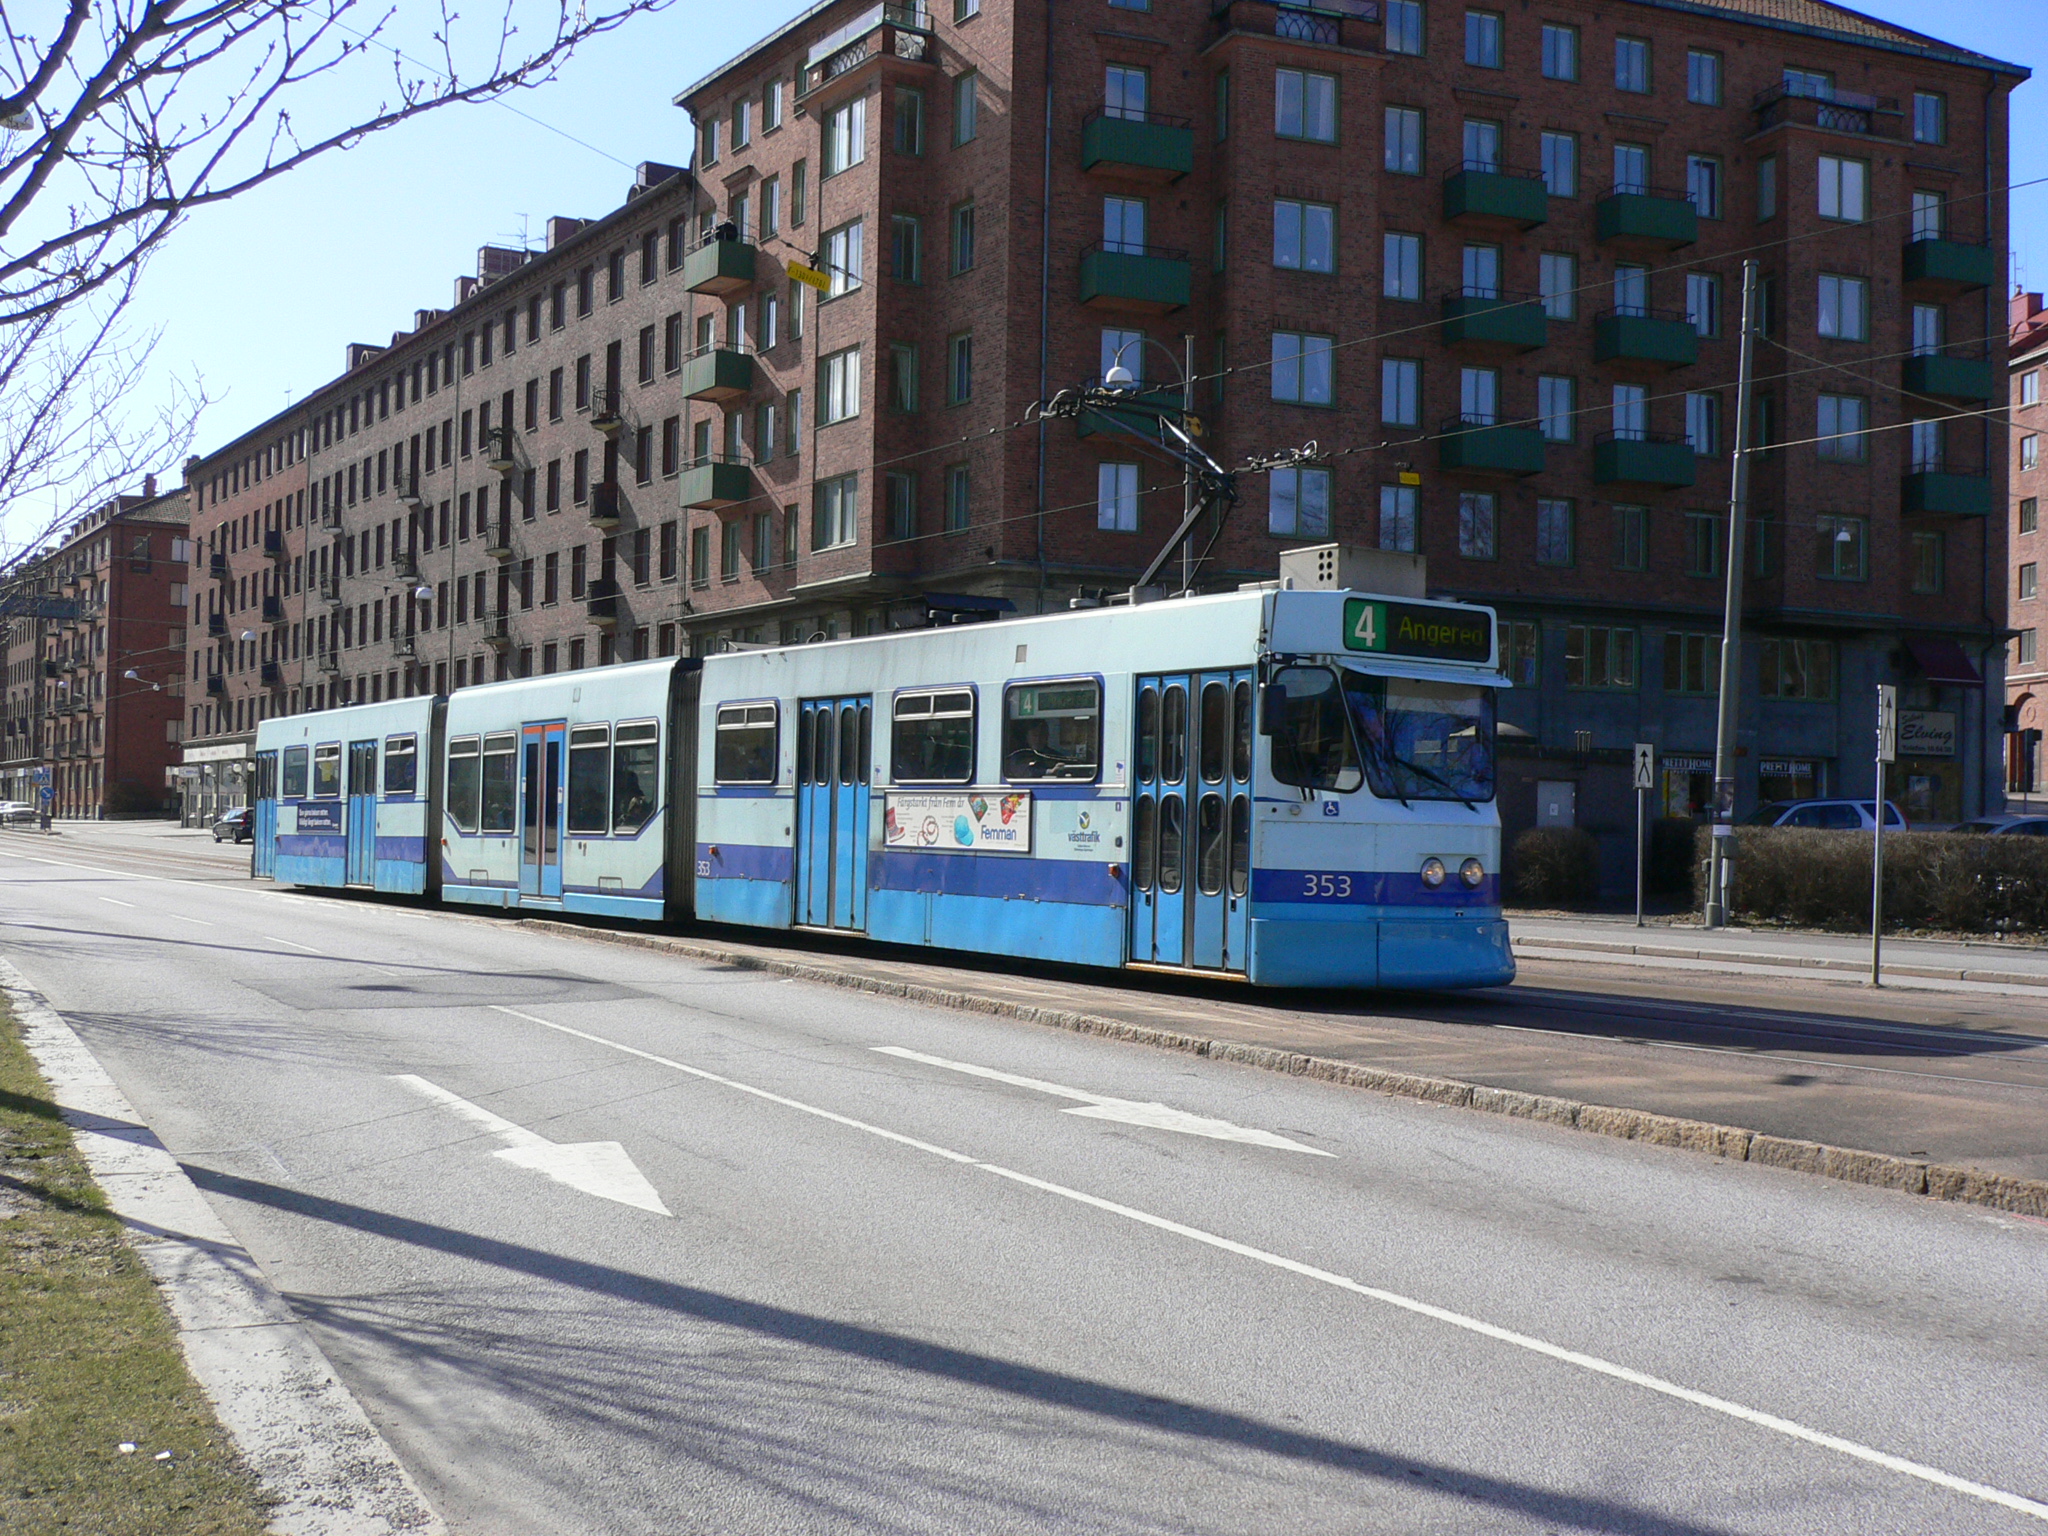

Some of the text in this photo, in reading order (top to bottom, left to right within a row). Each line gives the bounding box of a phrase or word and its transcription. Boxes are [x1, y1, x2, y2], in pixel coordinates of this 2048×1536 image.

[1354, 605, 1484, 647] 4 Angered
[1023, 692, 1032, 713] 4
[1901, 724, 1952, 745] Elving
[1689, 758, 1713, 770] HOME
[1760, 761, 1812, 774] PRETTY HOME
[980, 824, 1017, 841] Femman
[1067, 829, 1101, 842] västtrafik
[697, 860, 710, 876] 353
[1303, 874, 1351, 897] 353
